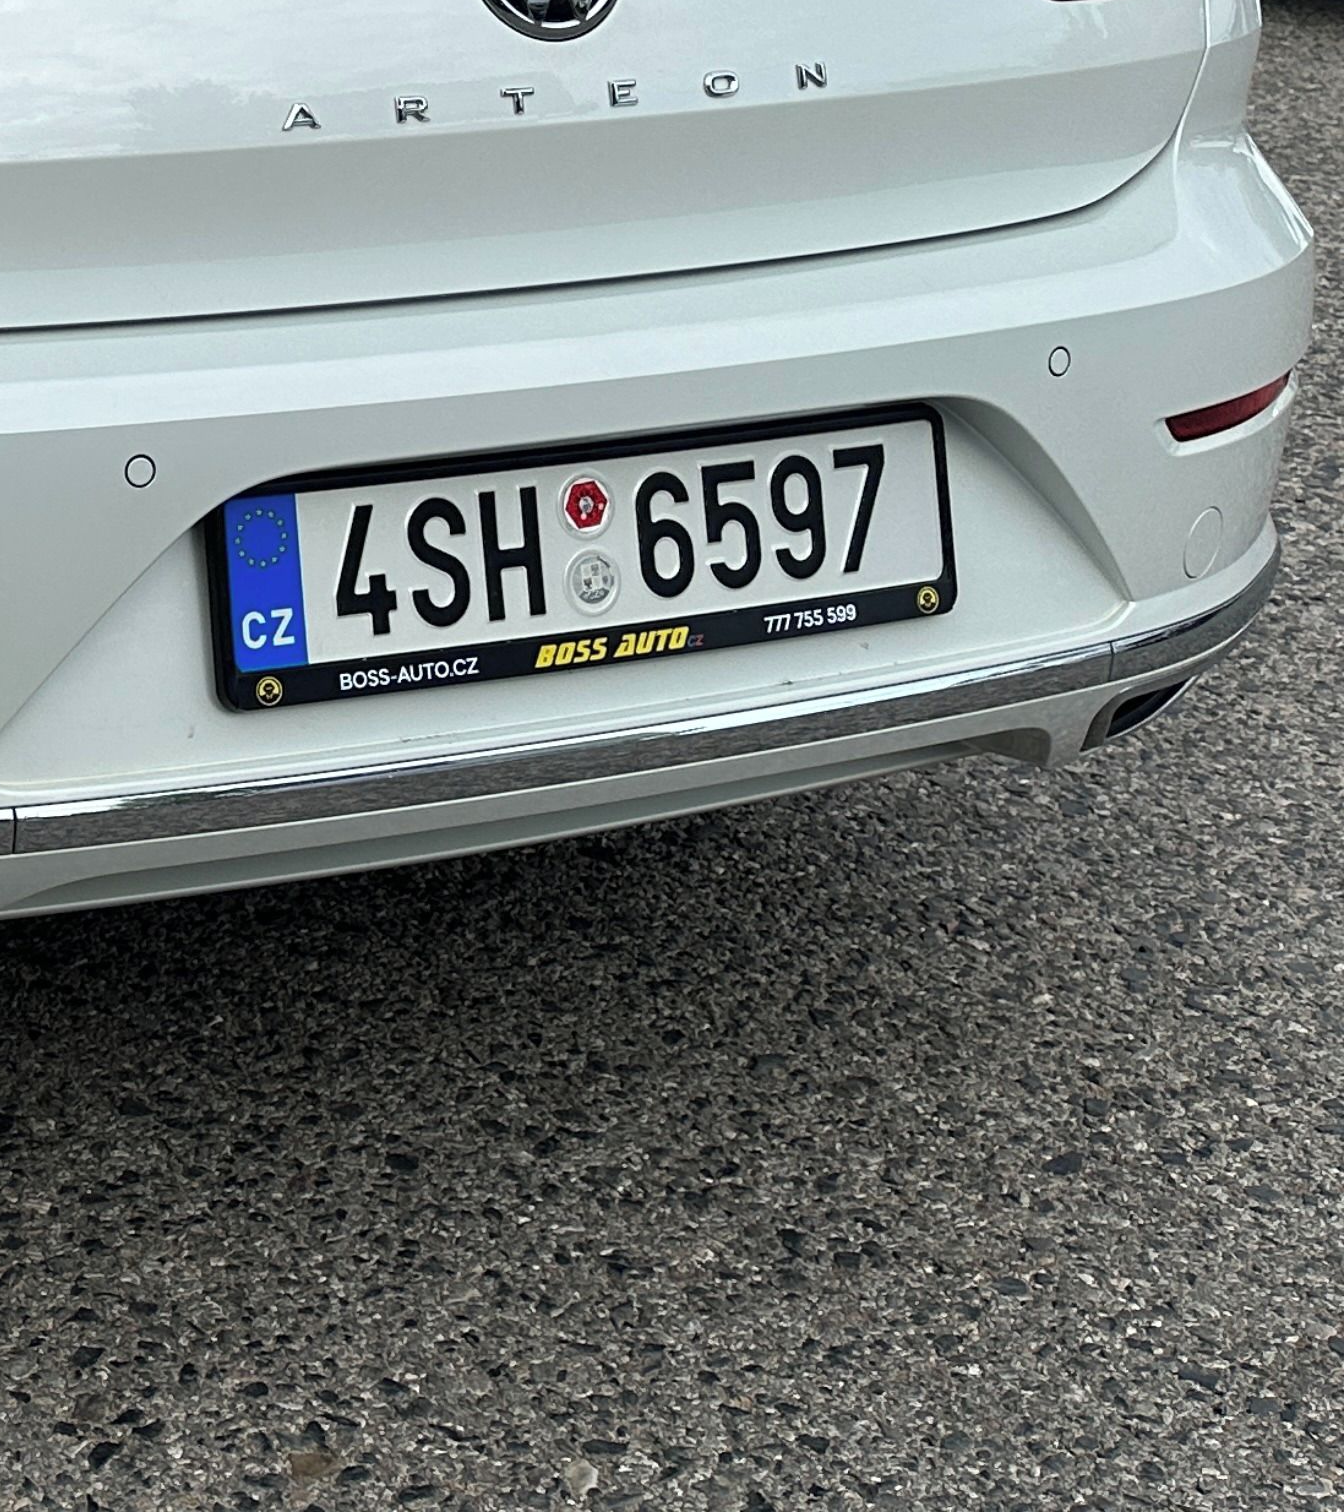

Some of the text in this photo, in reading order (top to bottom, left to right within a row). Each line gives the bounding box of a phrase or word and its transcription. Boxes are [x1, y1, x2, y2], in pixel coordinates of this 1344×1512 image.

[281, 60, 829, 132] ARTEON
[335, 443, 887, 637] 4SH 6597
[240, 605, 296, 650] CZ
[763, 603, 858, 634] 777 755 599
[534, 636, 608, 670] BOSS
[613, 625, 690, 660] AUTO
[338, 656, 480, 692] BOSS-AUTO.CZ
